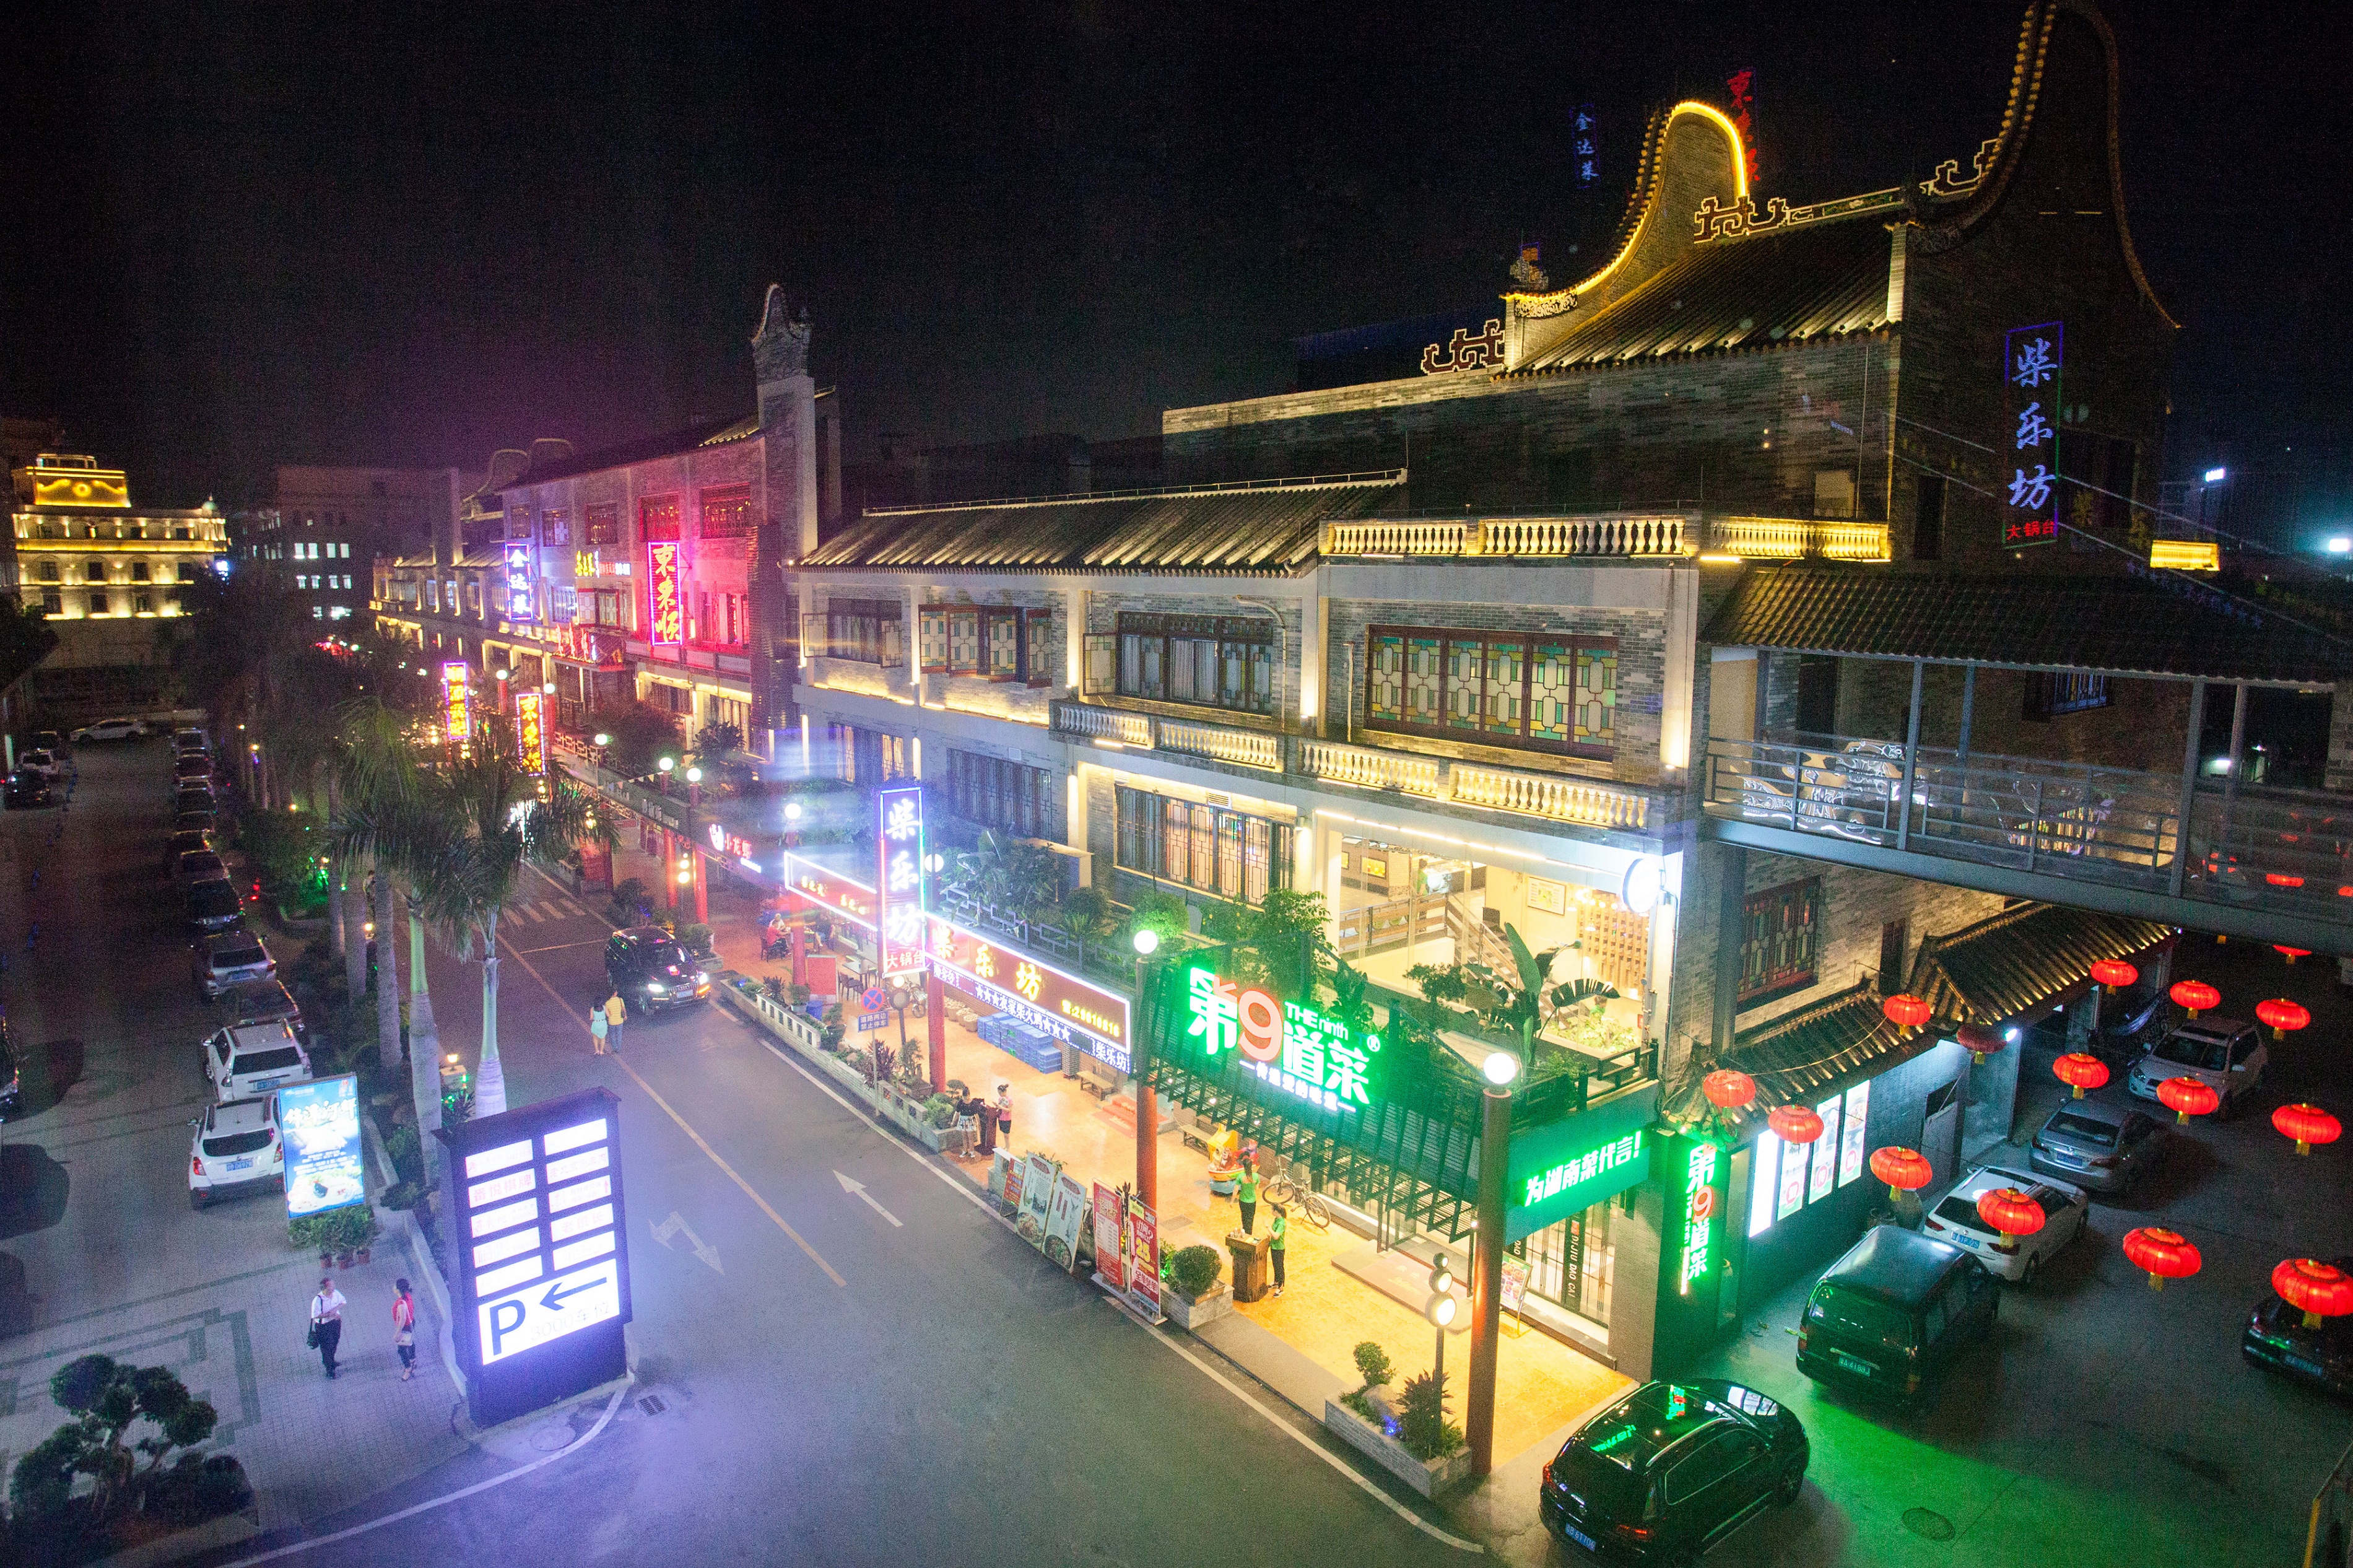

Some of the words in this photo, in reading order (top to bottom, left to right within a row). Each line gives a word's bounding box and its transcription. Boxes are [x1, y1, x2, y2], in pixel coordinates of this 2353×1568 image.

[2007, 338, 2058, 511] 柴乐坊
[2006, 520, 2056, 540] 大锅台
[885, 798, 923, 943] 柴乐坊
[933, 925, 1043, 1001] 柴乐坊
[861, 1020, 886, 1030] 禁止停车
[1188, 967, 1370, 1104] 第9道菜
[1285, 1001, 1318, 1028] THE
[1319, 1017, 1349, 1040] ninth
[1095, 1043, 1126, 1071] 柴乐坊
[1524, 1131, 1641, 1207] 为湖南菜代言!
[562, 1211, 604, 1234] 老班长
[1136, 1237, 1150, 1263] 25
[1570, 1235, 1579, 1261] DIJIU
[1568, 1263, 1577, 1280] DAO
[1567, 1283, 1576, 1298] CAI
[489, 1299, 526, 1356] P
[531, 1300, 610, 1341] 3000车位
